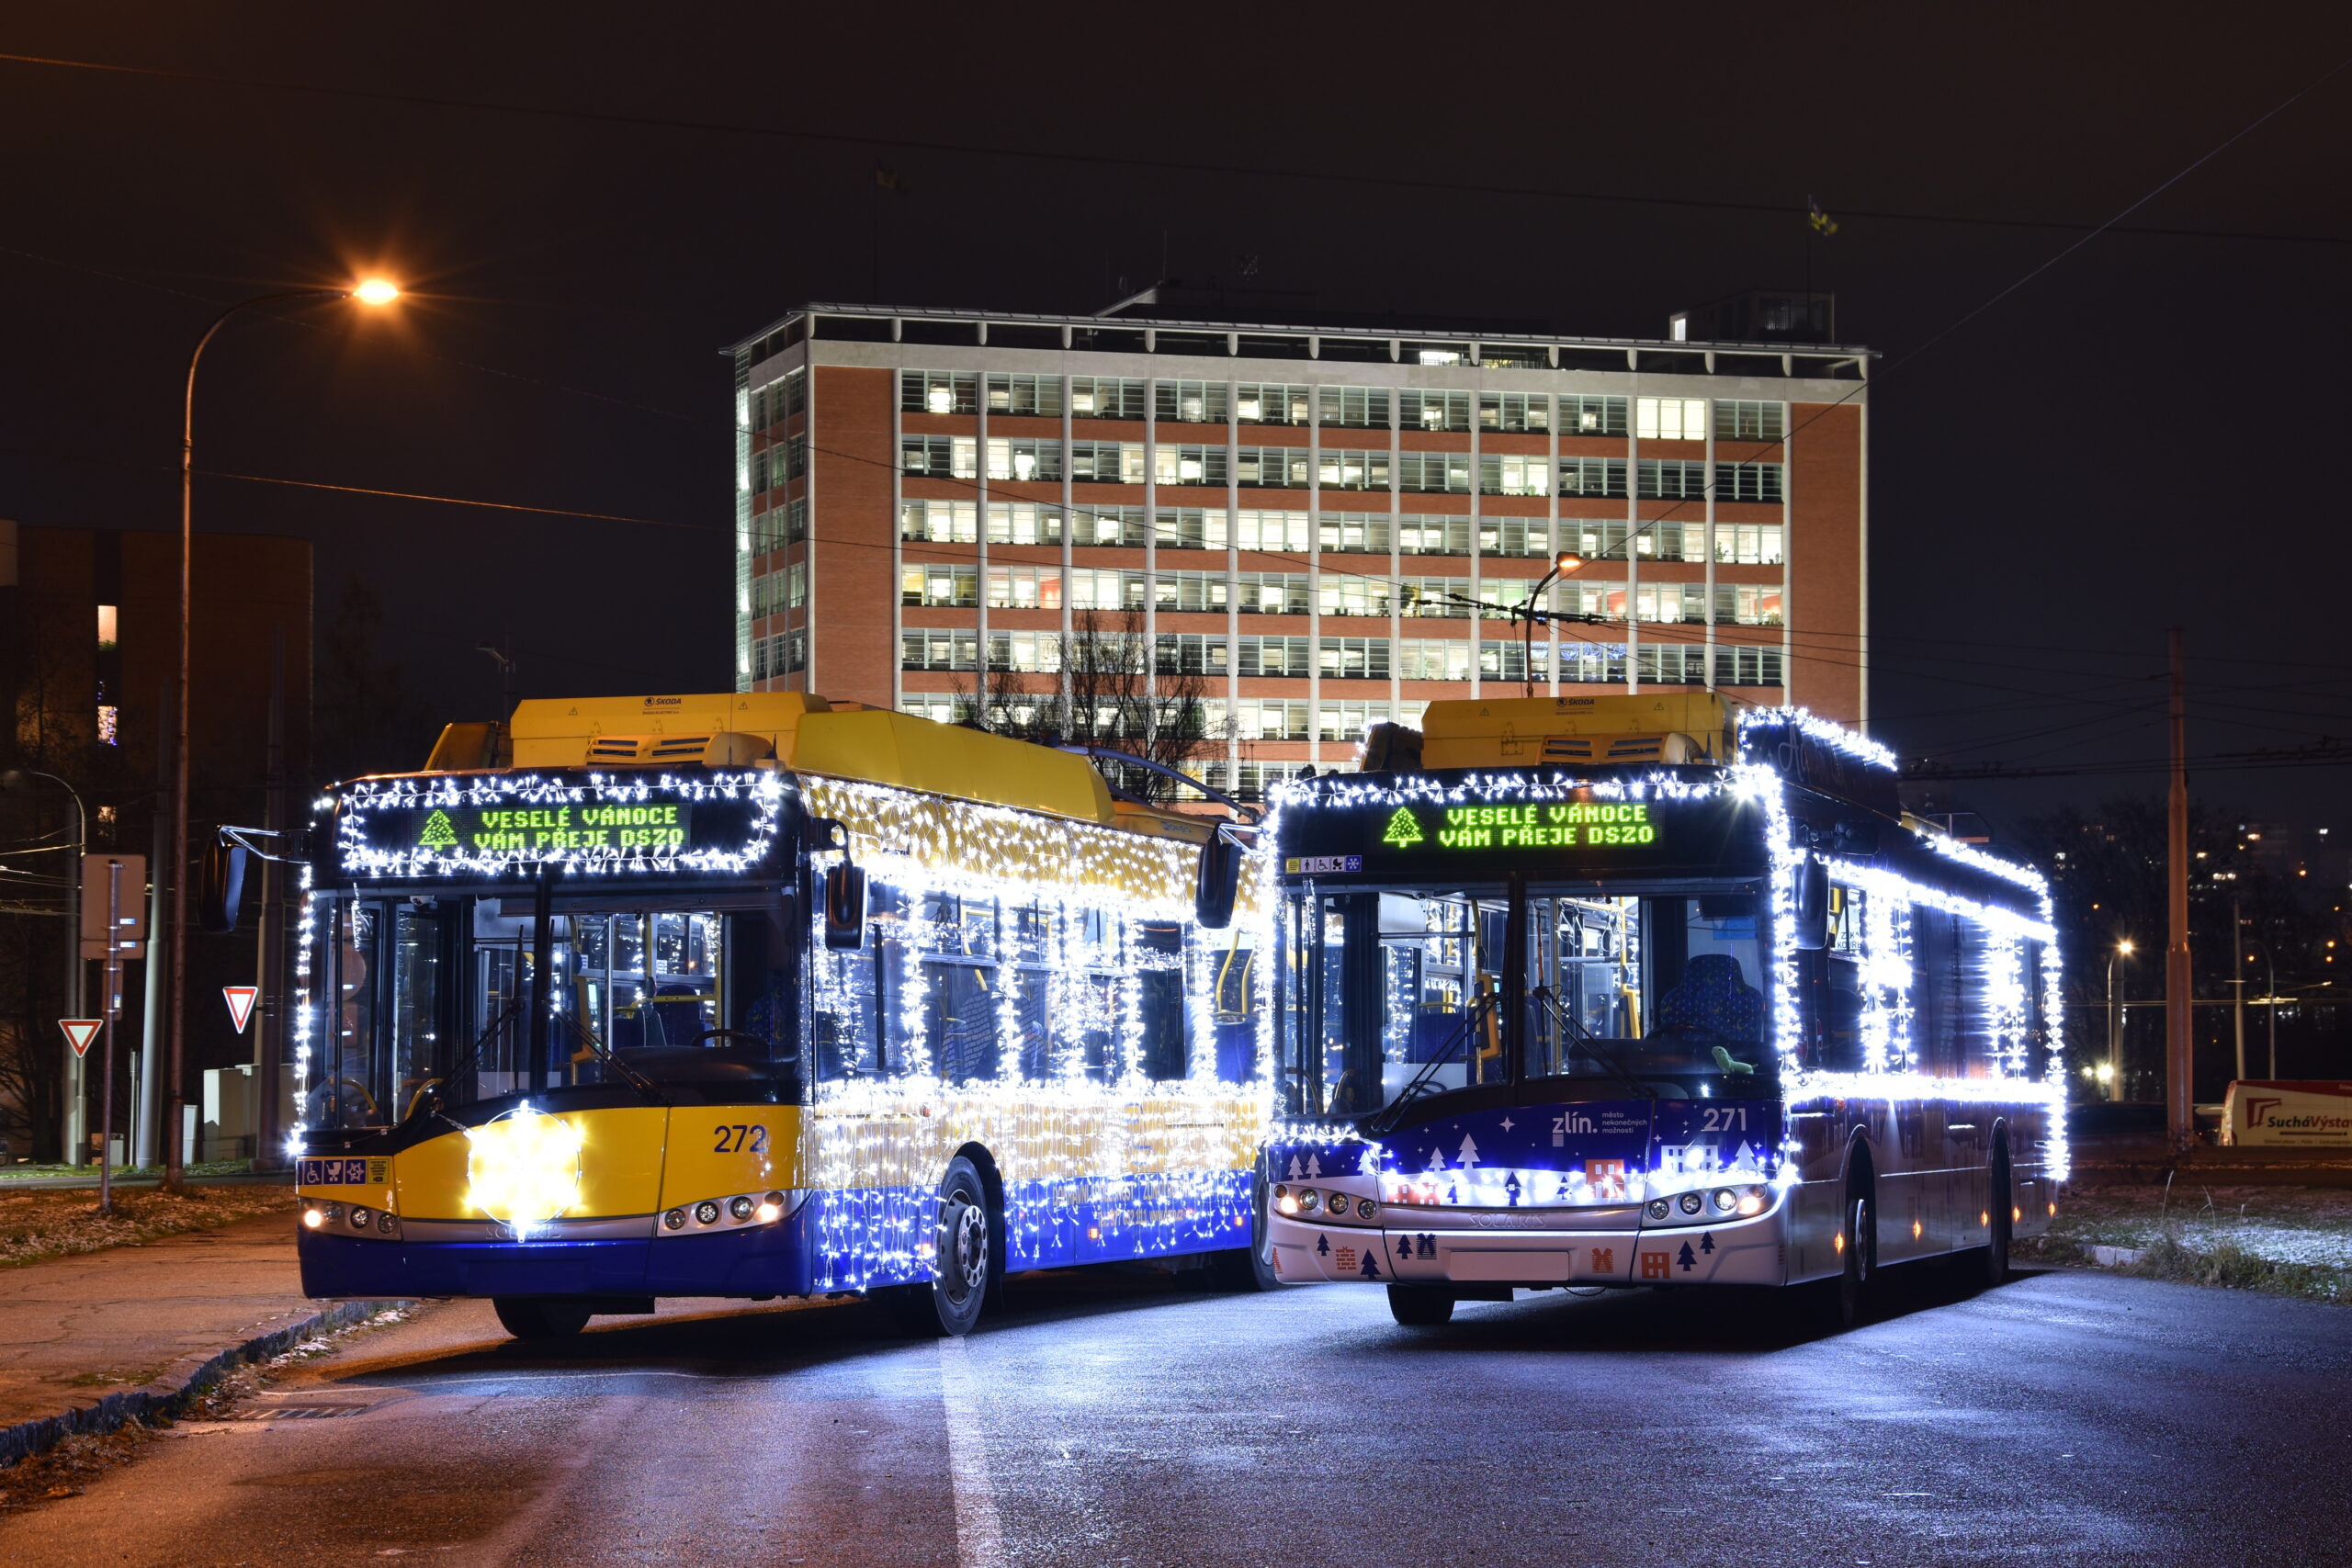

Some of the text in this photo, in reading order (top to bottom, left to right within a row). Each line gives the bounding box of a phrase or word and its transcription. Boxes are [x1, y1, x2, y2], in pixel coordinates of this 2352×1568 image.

[481, 804, 678, 829] VESELÉ VÁNOCE
[1447, 802, 1647, 826] VESELÉ VÁNOCE
[473, 827, 684, 851] VÁM PŘEJE DSZO
[1439, 825, 1654, 847] VÁM PŘEJE DSZO
[1552, 1111, 1599, 1134] zlín.
[1601, 1119, 1647, 1127] nekonečných
[1702, 1108, 1747, 1132] 271
[713, 1124, 767, 1153] 272
[485, 1224, 562, 1240] SOLIS
[1469, 1213, 1547, 1228] SOLARIS
